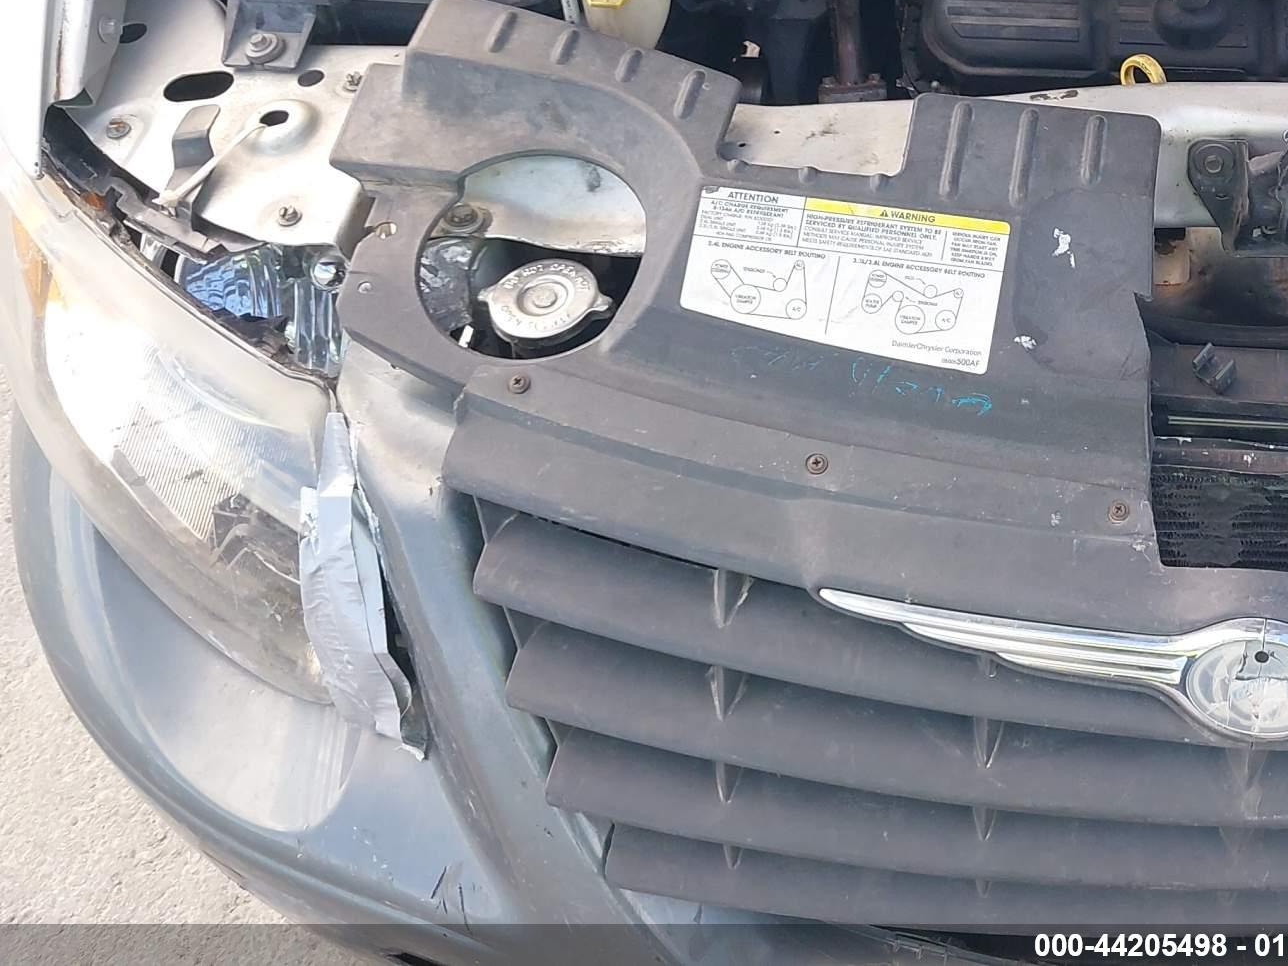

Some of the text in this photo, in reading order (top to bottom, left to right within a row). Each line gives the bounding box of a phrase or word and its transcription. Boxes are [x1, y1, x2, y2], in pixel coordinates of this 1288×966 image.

[728, 191, 779, 204] ATTENTION
[806, 213, 854, 224] HIGH-PRESSURE
[856, 218, 898, 229] REFRIGERANT
[900, 224, 923, 232] SYSTEM
[890, 210, 936, 223] WARNING
[805, 219, 836, 228] SERVICED
[847, 224, 880, 233] QUALIFIED
[881, 228, 918, 238] PERSONNEL
[721, 242, 744, 250] ENGINE
[745, 245, 782, 254] ACCESSORY
[798, 250, 826, 260] ROUTING
[881, 260, 905, 269] ENGINE
[905, 264, 942, 274] ACCESSORY
[958, 269, 986, 279] ROUTING
[891, 339, 982, 356] DaimlerChrysler Corporation
